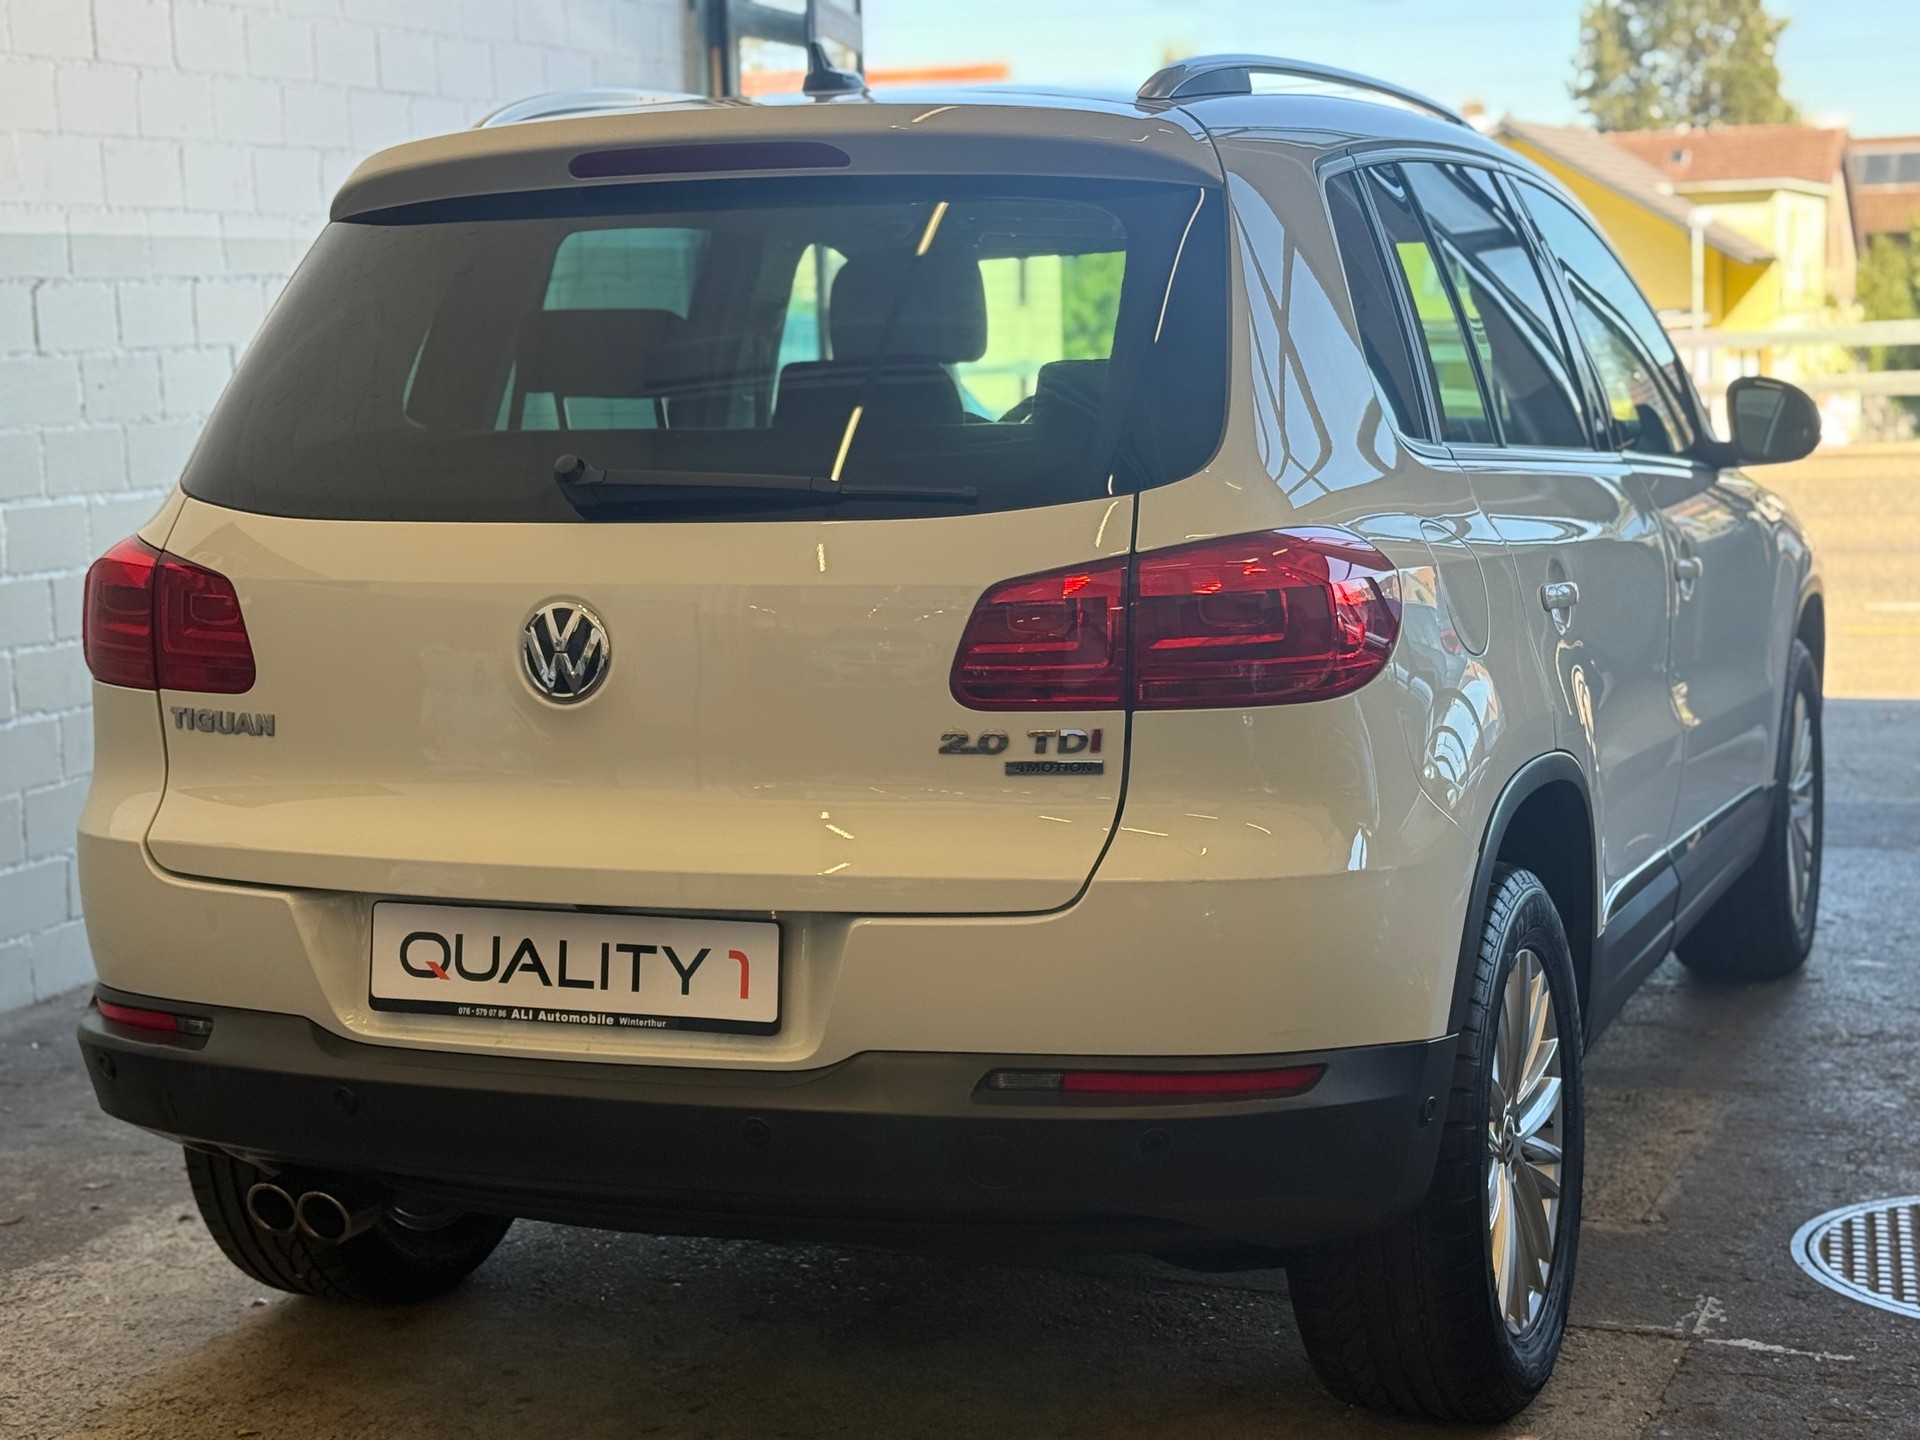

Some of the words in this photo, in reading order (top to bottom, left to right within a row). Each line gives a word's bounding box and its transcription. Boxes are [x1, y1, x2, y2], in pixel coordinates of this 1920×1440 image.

[170, 706, 275, 737] TIGUAN
[938, 728, 1009, 755] 2.0
[1027, 728, 1103, 754] TDI
[1015, 763, 1093, 774] 4MOTION
[400, 931, 711, 996] QUALITY
[728, 950, 749, 999] 1
[511, 1009, 533, 1020] ALI
[538, 1010, 614, 1025] Automobile
[619, 1017, 667, 1028] Winterthur
